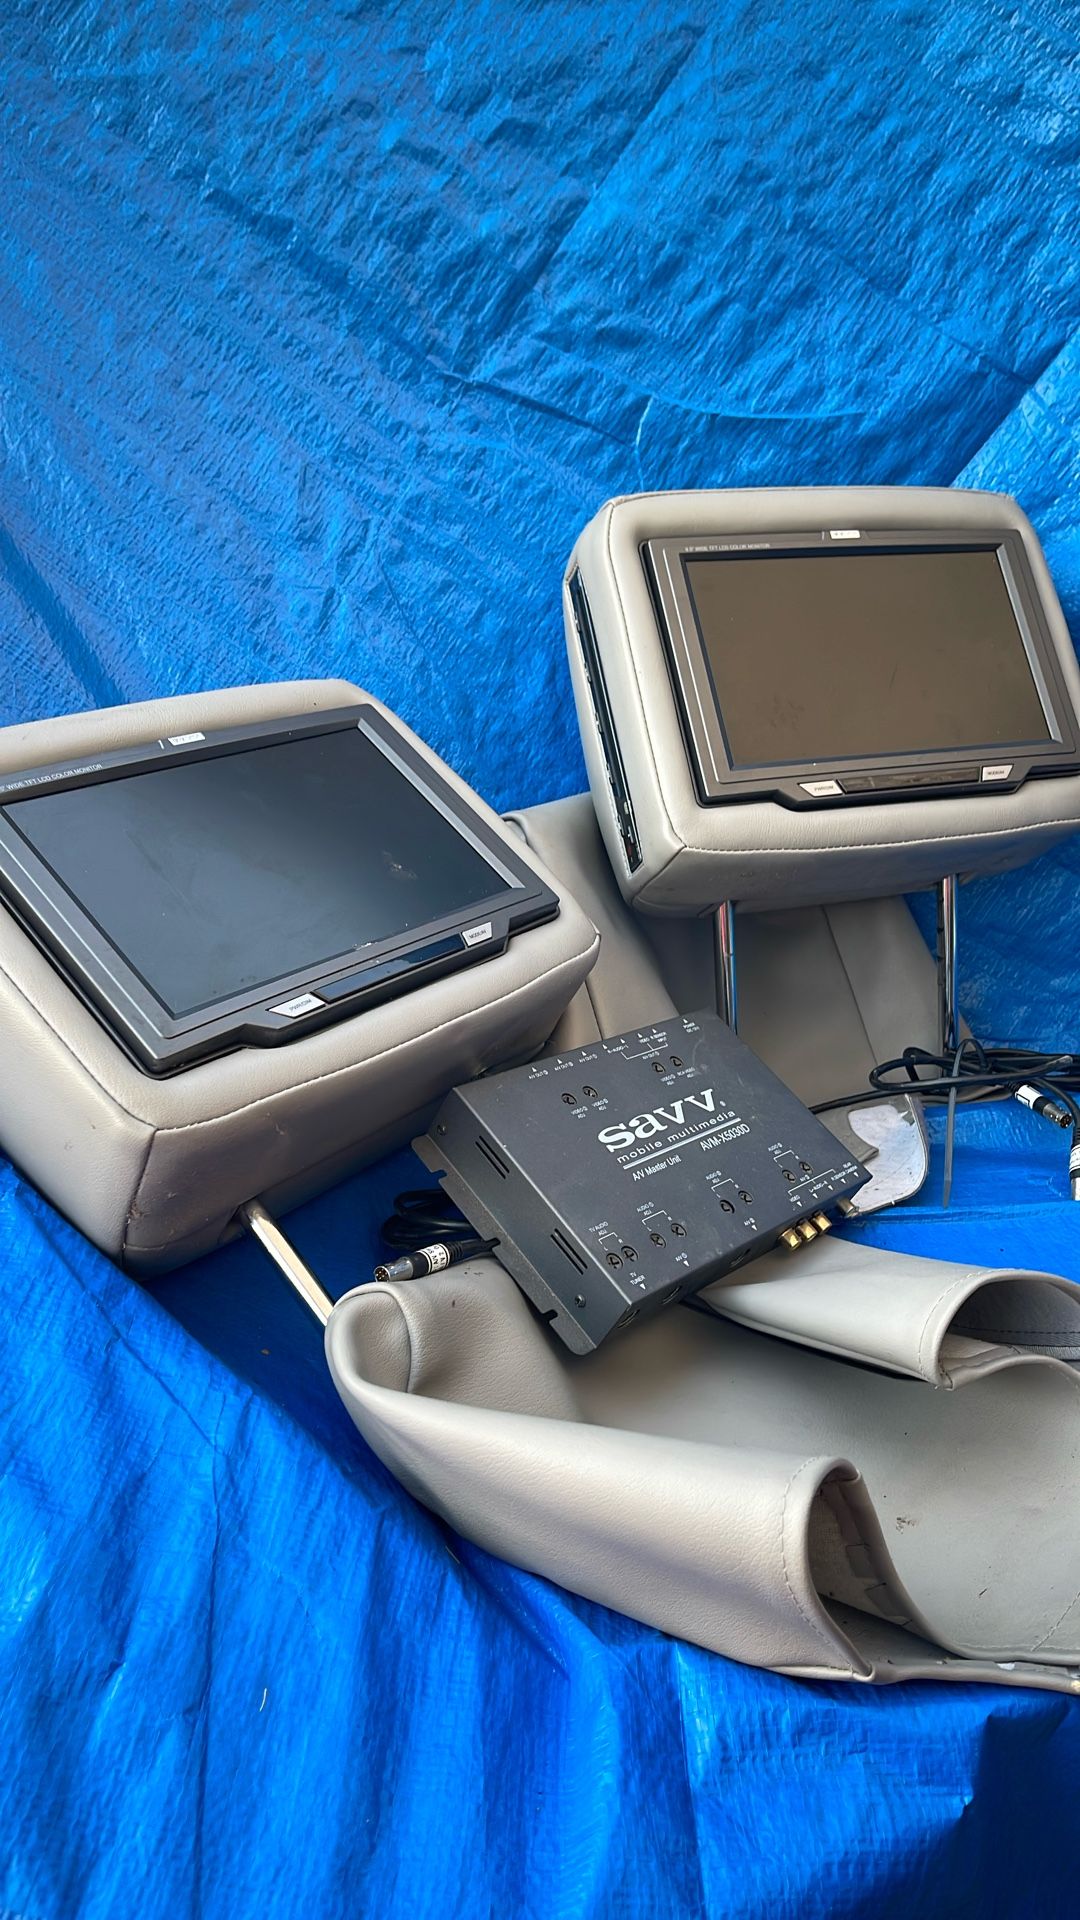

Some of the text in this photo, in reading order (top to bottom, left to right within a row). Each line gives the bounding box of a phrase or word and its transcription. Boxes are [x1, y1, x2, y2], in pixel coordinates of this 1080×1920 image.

[24, 779, 37, 787] TFT
[37, 775, 51, 784] LCD
[51, 770, 74, 781] COLOR
[74, 764, 103, 775] MONITOR
[598, 1088, 715, 1153] savv
[616, 1110, 735, 1164] mobile multimedia
[699, 1124, 750, 1151] AVM-X5030D
[632, 1155, 682, 1182] A/V Master Unit
[595, 1221, 609, 1230] AUDIO
